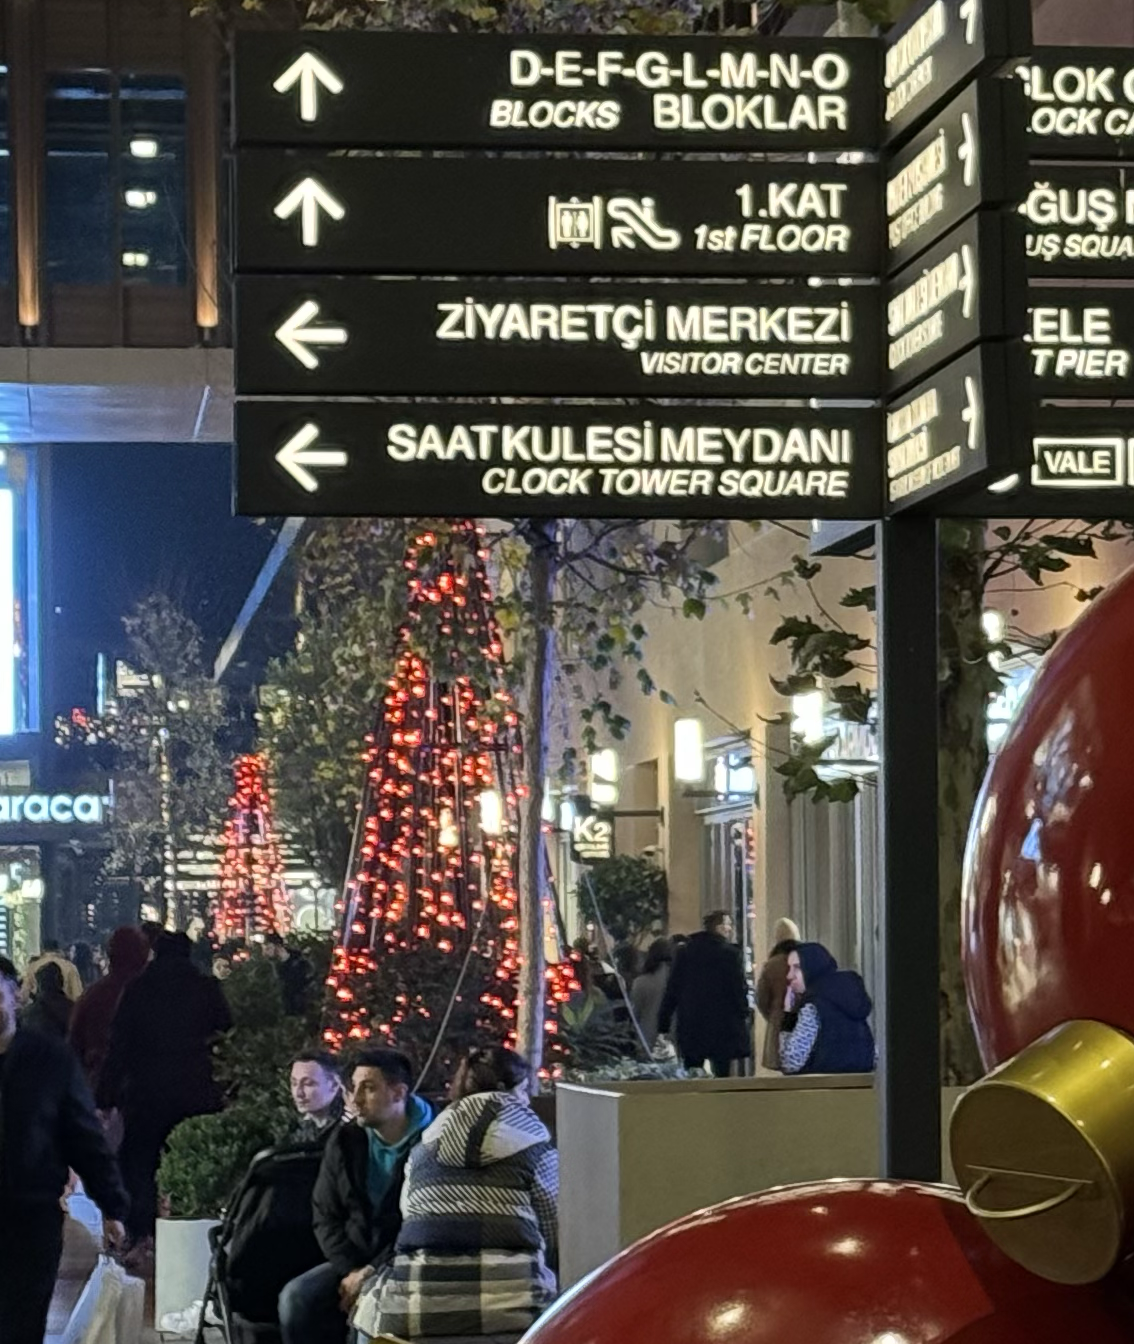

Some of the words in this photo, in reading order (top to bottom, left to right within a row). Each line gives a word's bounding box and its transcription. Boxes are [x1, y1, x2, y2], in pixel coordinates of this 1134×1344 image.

[509, 49, 850, 90] D-E-F-G-L-M-N-O
[489, 99, 621, 130] BLOCKS
[653, 92, 848, 131] BLOKLAR
[1026, 106, 1102, 136] OCK
[735, 183, 848, 219] 1.KAT
[1018, 181, 1118, 233] ĞUŞ
[694, 223, 738, 252] 1st
[740, 223, 851, 253] FLOOR
[435, 296, 656, 351] ZİYARETÇİ
[666, 300, 851, 344] MERKEZİ
[1023, 307, 1112, 346] ELE
[640, 351, 743, 375] VISITOR
[744, 352, 851, 376] CENTER
[1055, 348, 1130, 378] PIER
[386, 423, 499, 462] SAAT
[501, 420, 655, 464] KULESİ
[660, 426, 852, 465] MEYDANI
[1043, 449, 1112, 475] VALE
[481, 467, 594, 495] CLOCK
[598, 468, 712, 496] TOWER
[717, 469, 850, 498] SQUARE
[574, 814, 612, 842] K2
